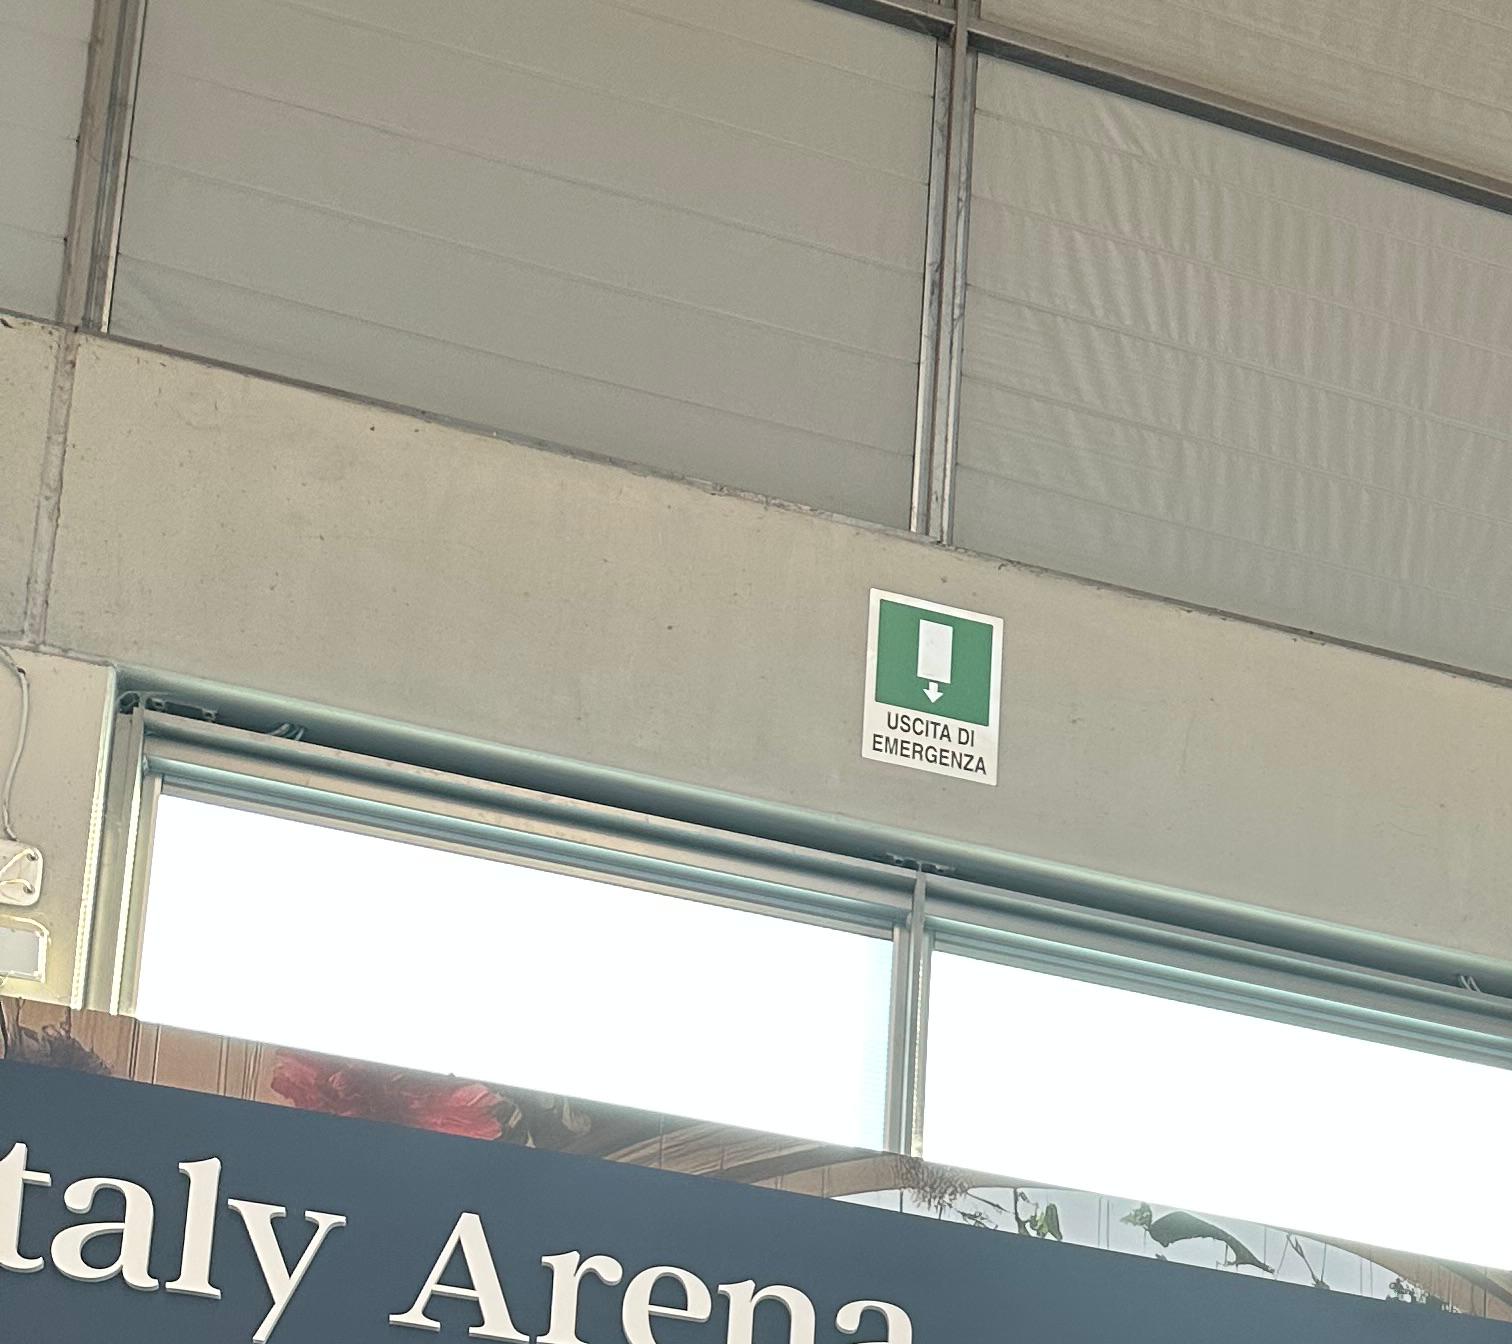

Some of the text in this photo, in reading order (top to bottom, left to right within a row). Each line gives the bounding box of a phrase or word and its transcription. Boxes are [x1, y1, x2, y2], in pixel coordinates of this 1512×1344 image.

[887, 711, 975, 747] USCITA DI
[872, 733, 987, 775] EMERGENZA
